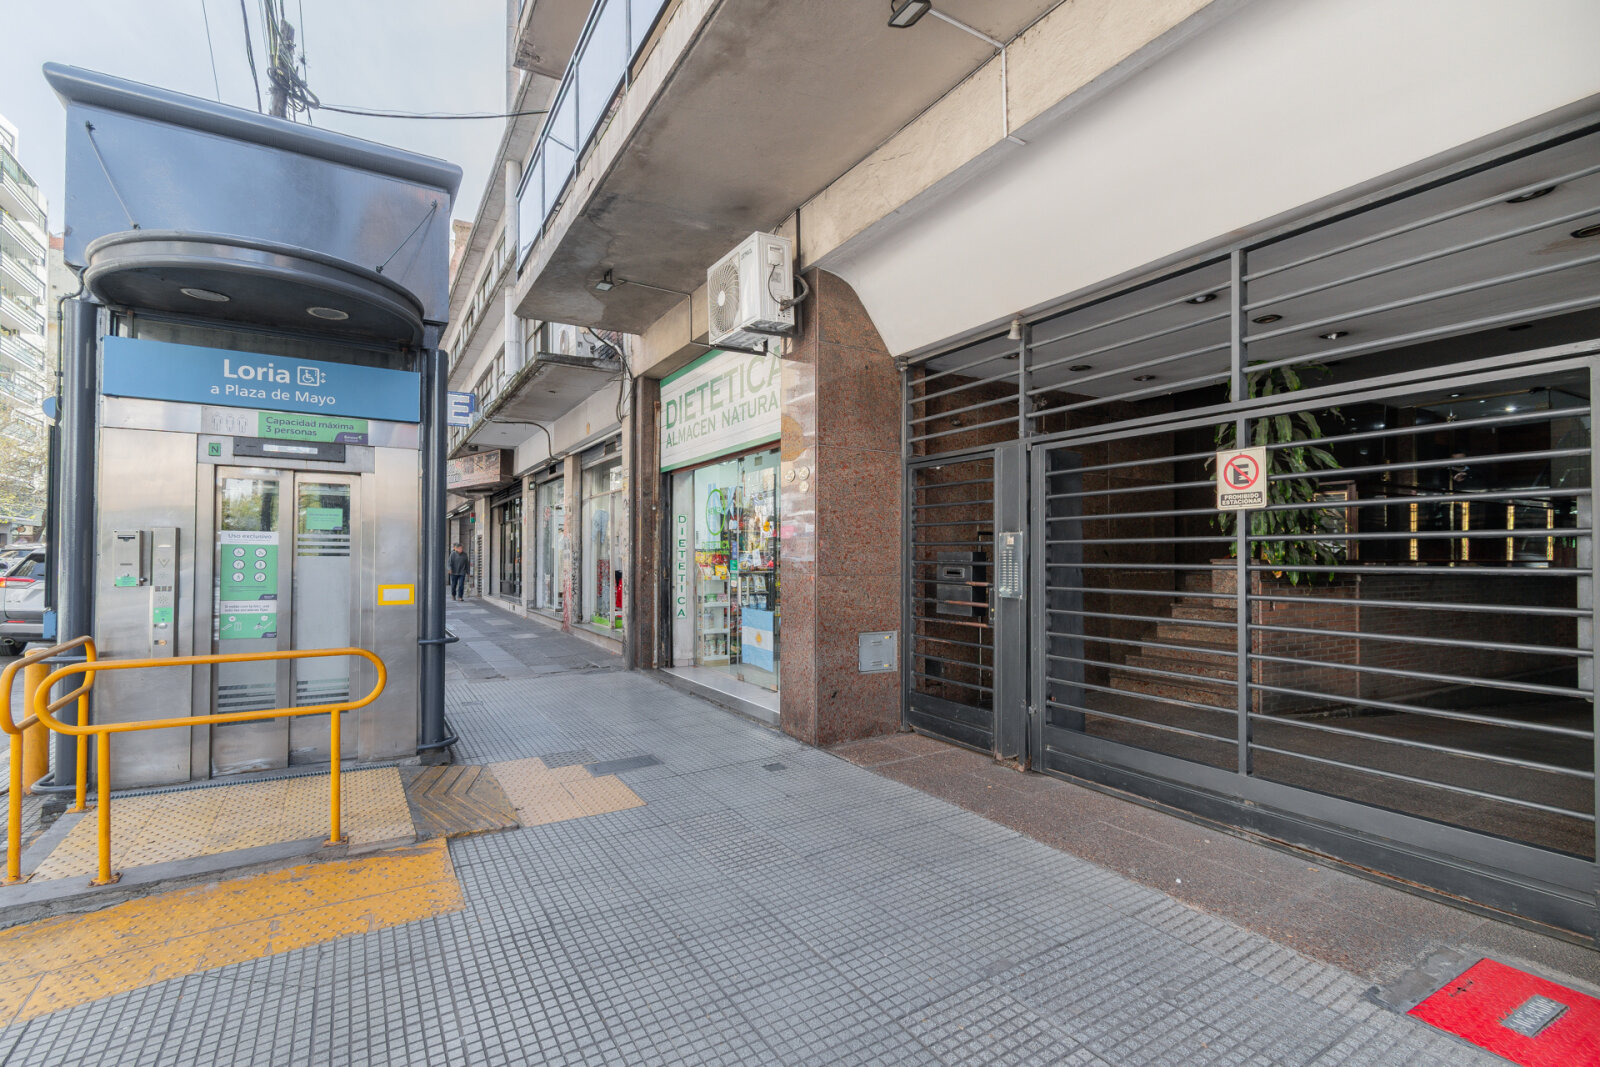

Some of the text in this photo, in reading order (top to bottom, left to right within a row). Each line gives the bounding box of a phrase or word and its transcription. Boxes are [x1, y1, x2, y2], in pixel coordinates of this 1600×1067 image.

[223, 359, 290, 384] Loria
[210, 384, 336, 407] a Plaza de Mayo
[666, 345, 781, 430] DIETETICA
[265, 416, 355, 430] Capacidad máxima
[265, 425, 318, 436] 3 personas
[666, 389, 781, 448] ALMACEN NATURA
[1222, 497, 1262, 505] ESTACIONAR
[677, 515, 687, 616] DIETETICA
